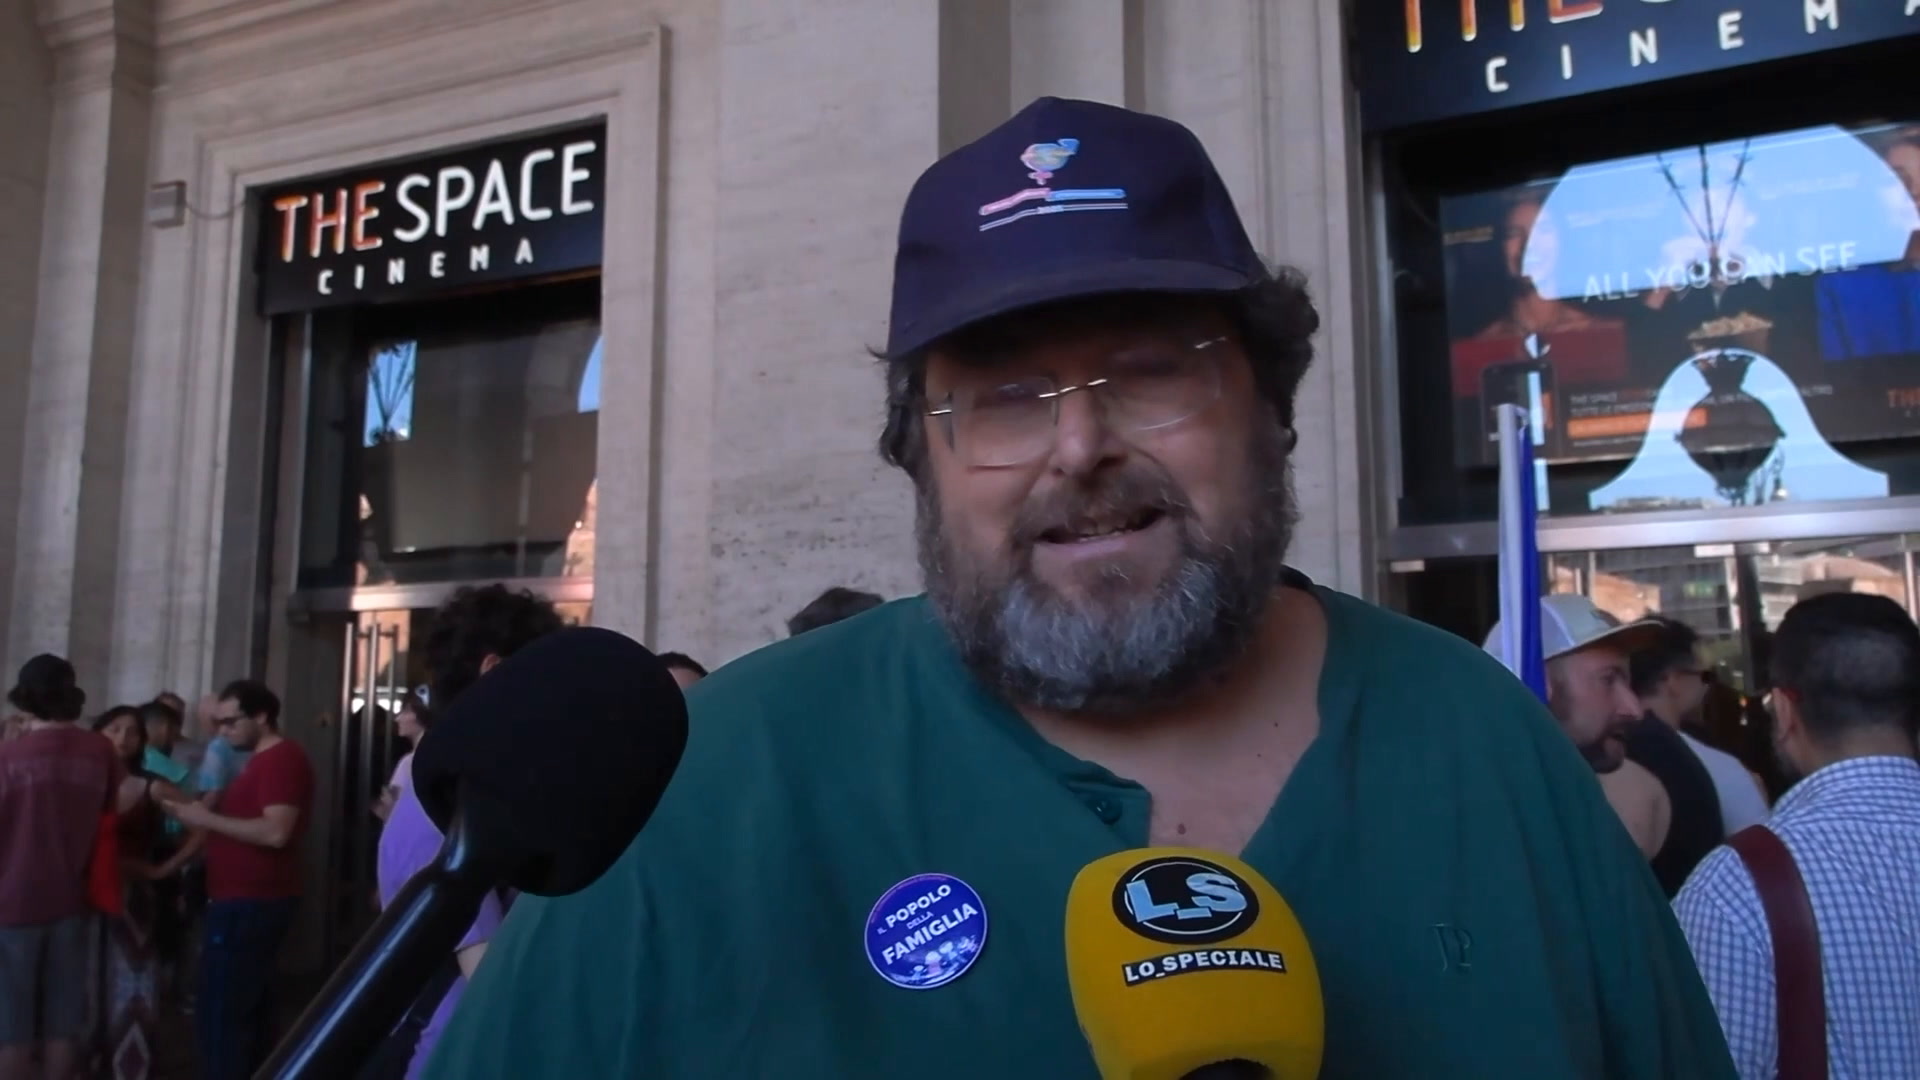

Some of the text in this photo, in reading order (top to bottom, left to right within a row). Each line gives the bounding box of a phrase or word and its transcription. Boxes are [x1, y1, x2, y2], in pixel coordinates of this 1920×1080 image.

[274, 140, 597, 263] THE SPACE
[317, 237, 534, 294] CINEMA
[1582, 240, 1860, 303] ALL YOU CAN SEE
[881, 902, 979, 966] FAMIGLIA
[885, 884, 952, 929] POPOLO
[906, 911, 935, 929] DELLA
